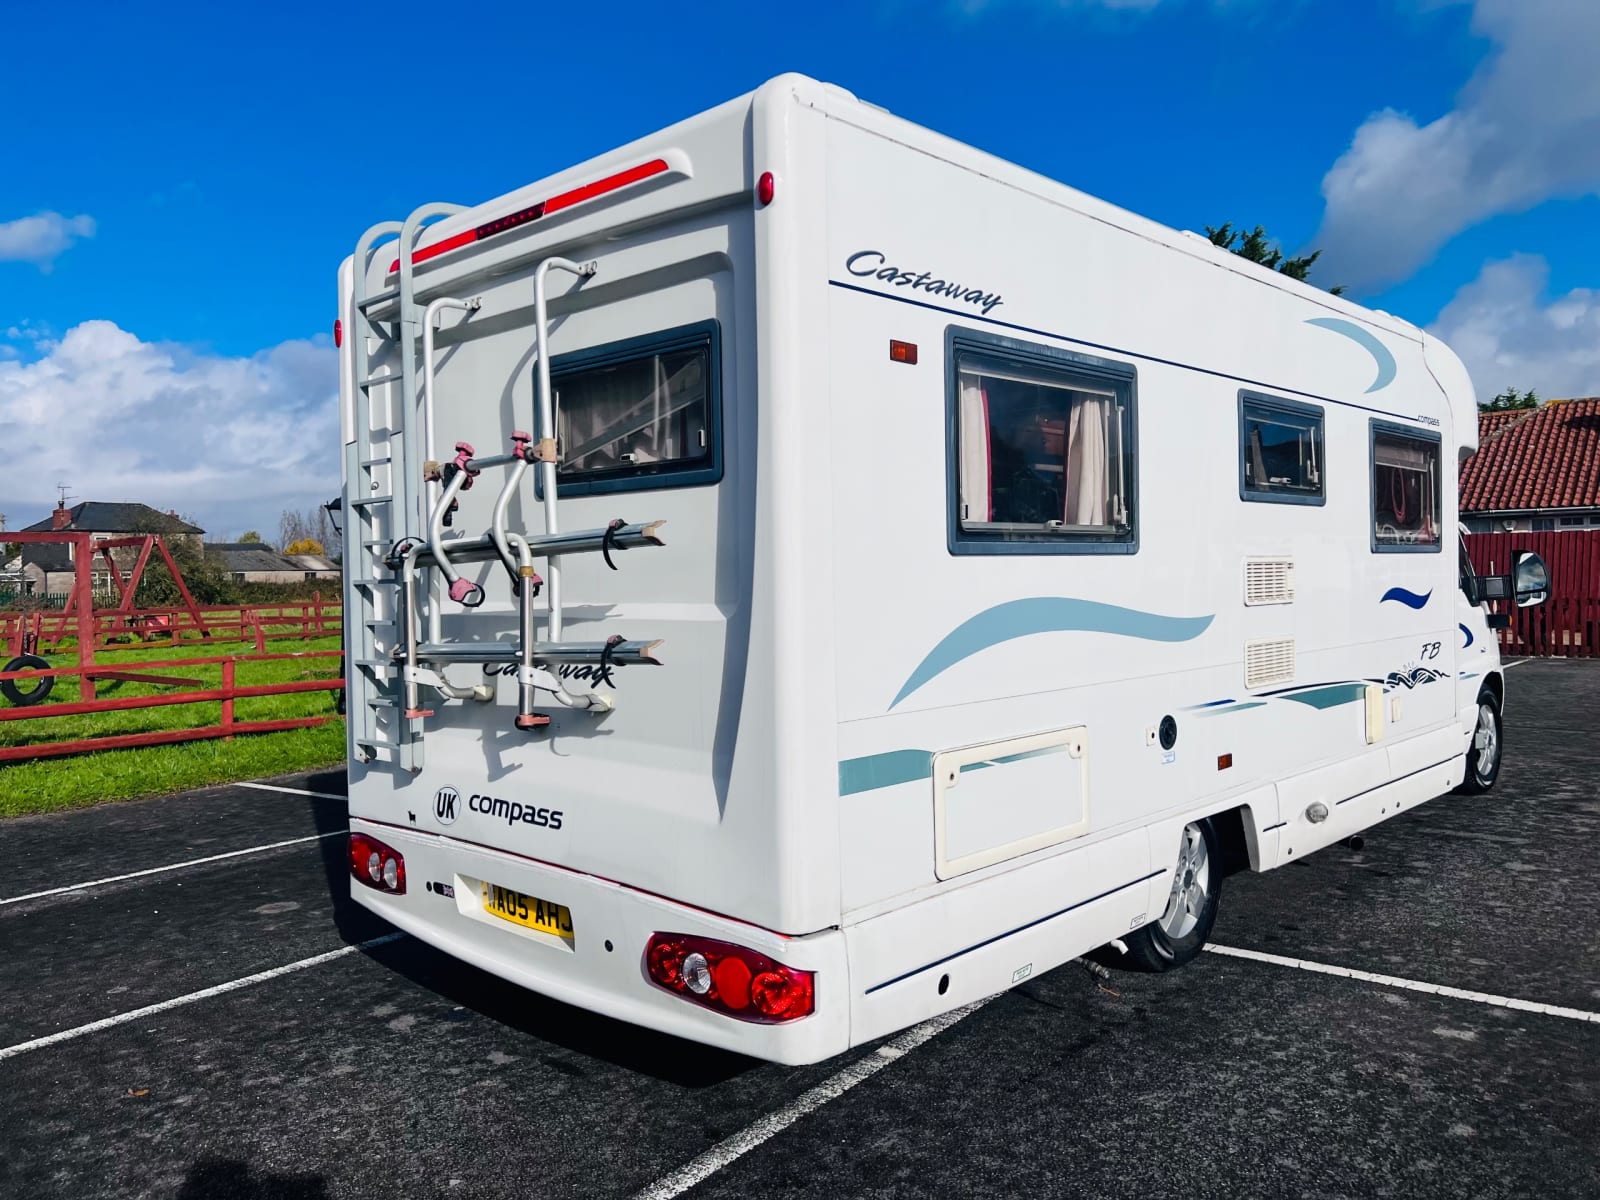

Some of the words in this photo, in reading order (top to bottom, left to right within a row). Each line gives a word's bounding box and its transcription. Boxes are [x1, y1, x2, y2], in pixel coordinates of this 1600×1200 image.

[846, 250, 1003, 315] Castaway
[1420, 641, 1442, 660] FB
[436, 792, 457, 819] UK
[469, 794, 563, 830] compass
